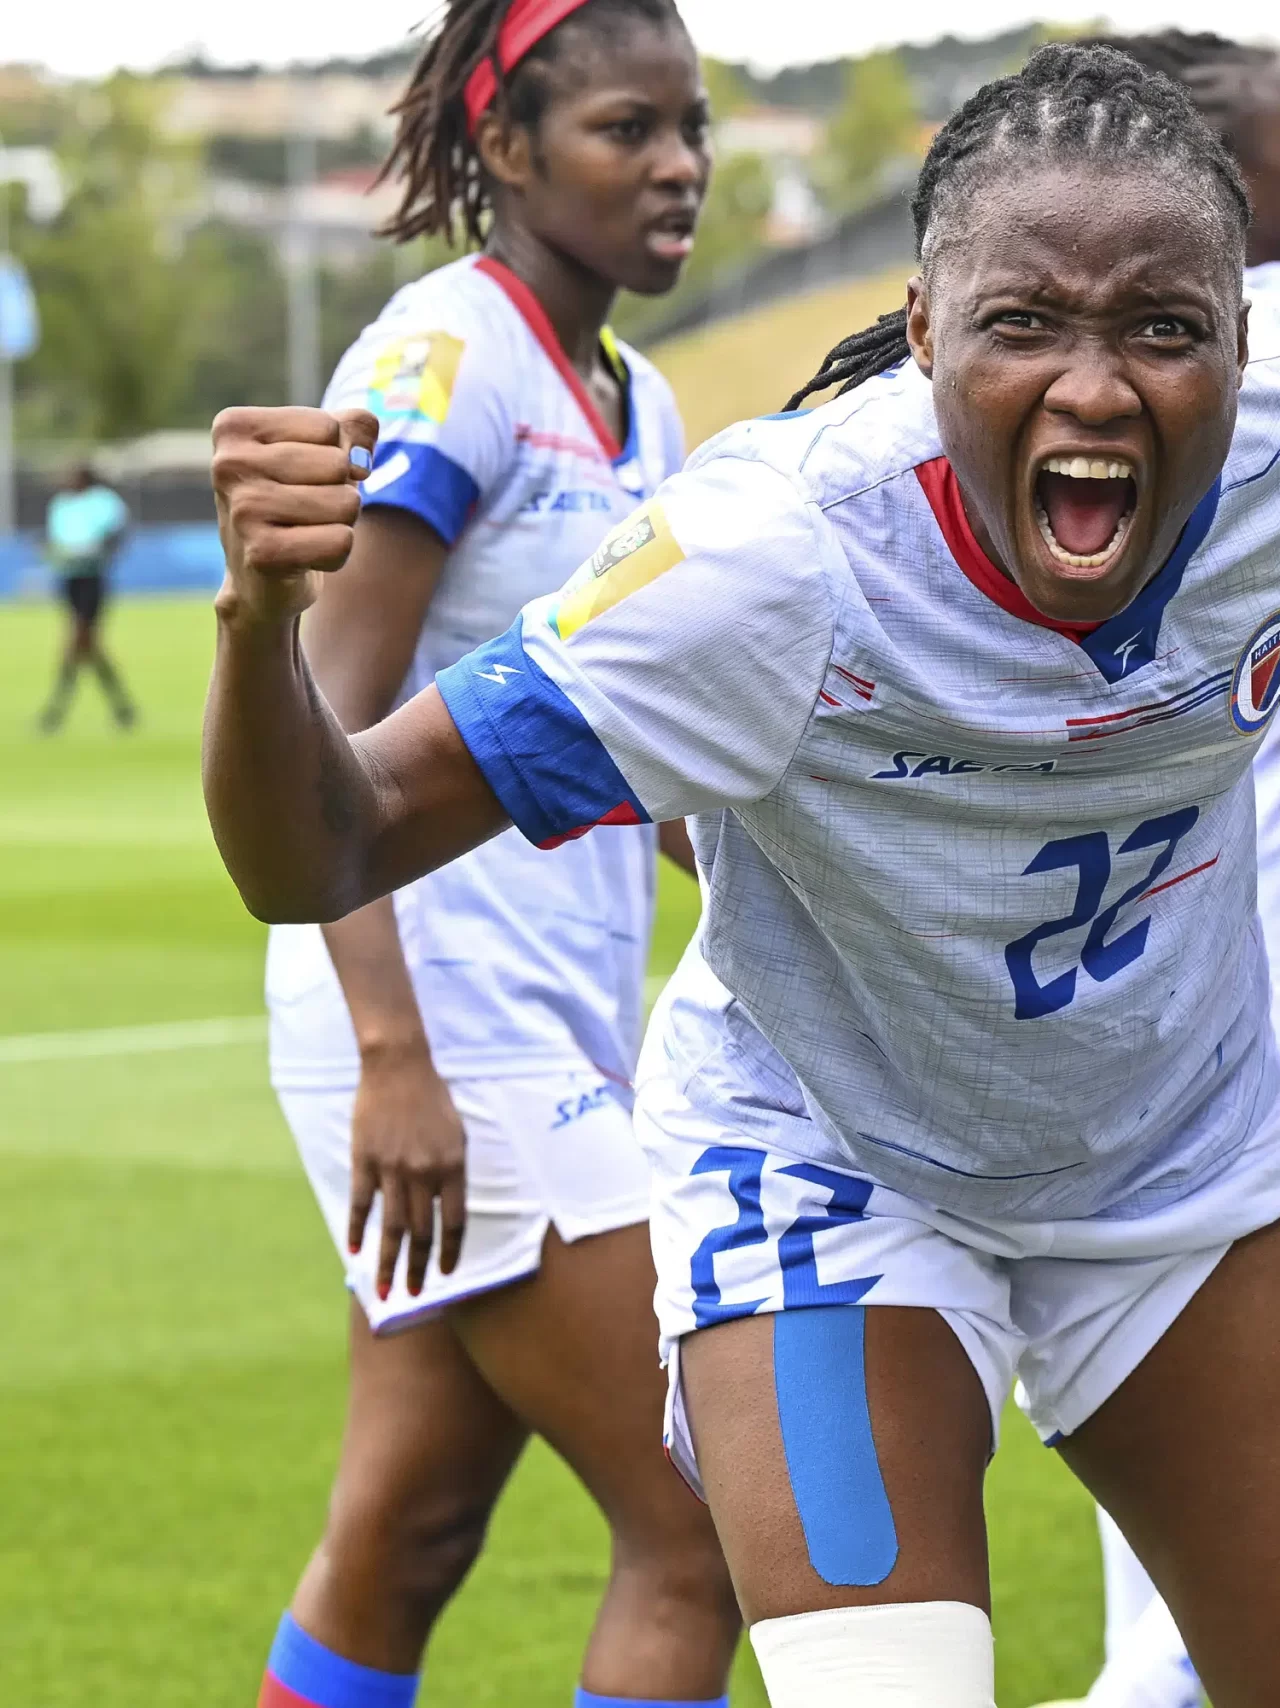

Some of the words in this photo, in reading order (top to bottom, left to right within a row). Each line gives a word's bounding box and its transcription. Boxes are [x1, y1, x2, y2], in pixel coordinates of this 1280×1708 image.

[871, 750, 1056, 780] SAETA
[1005, 805, 1199, 1020] 22
[689, 1146, 885, 1329] 22
